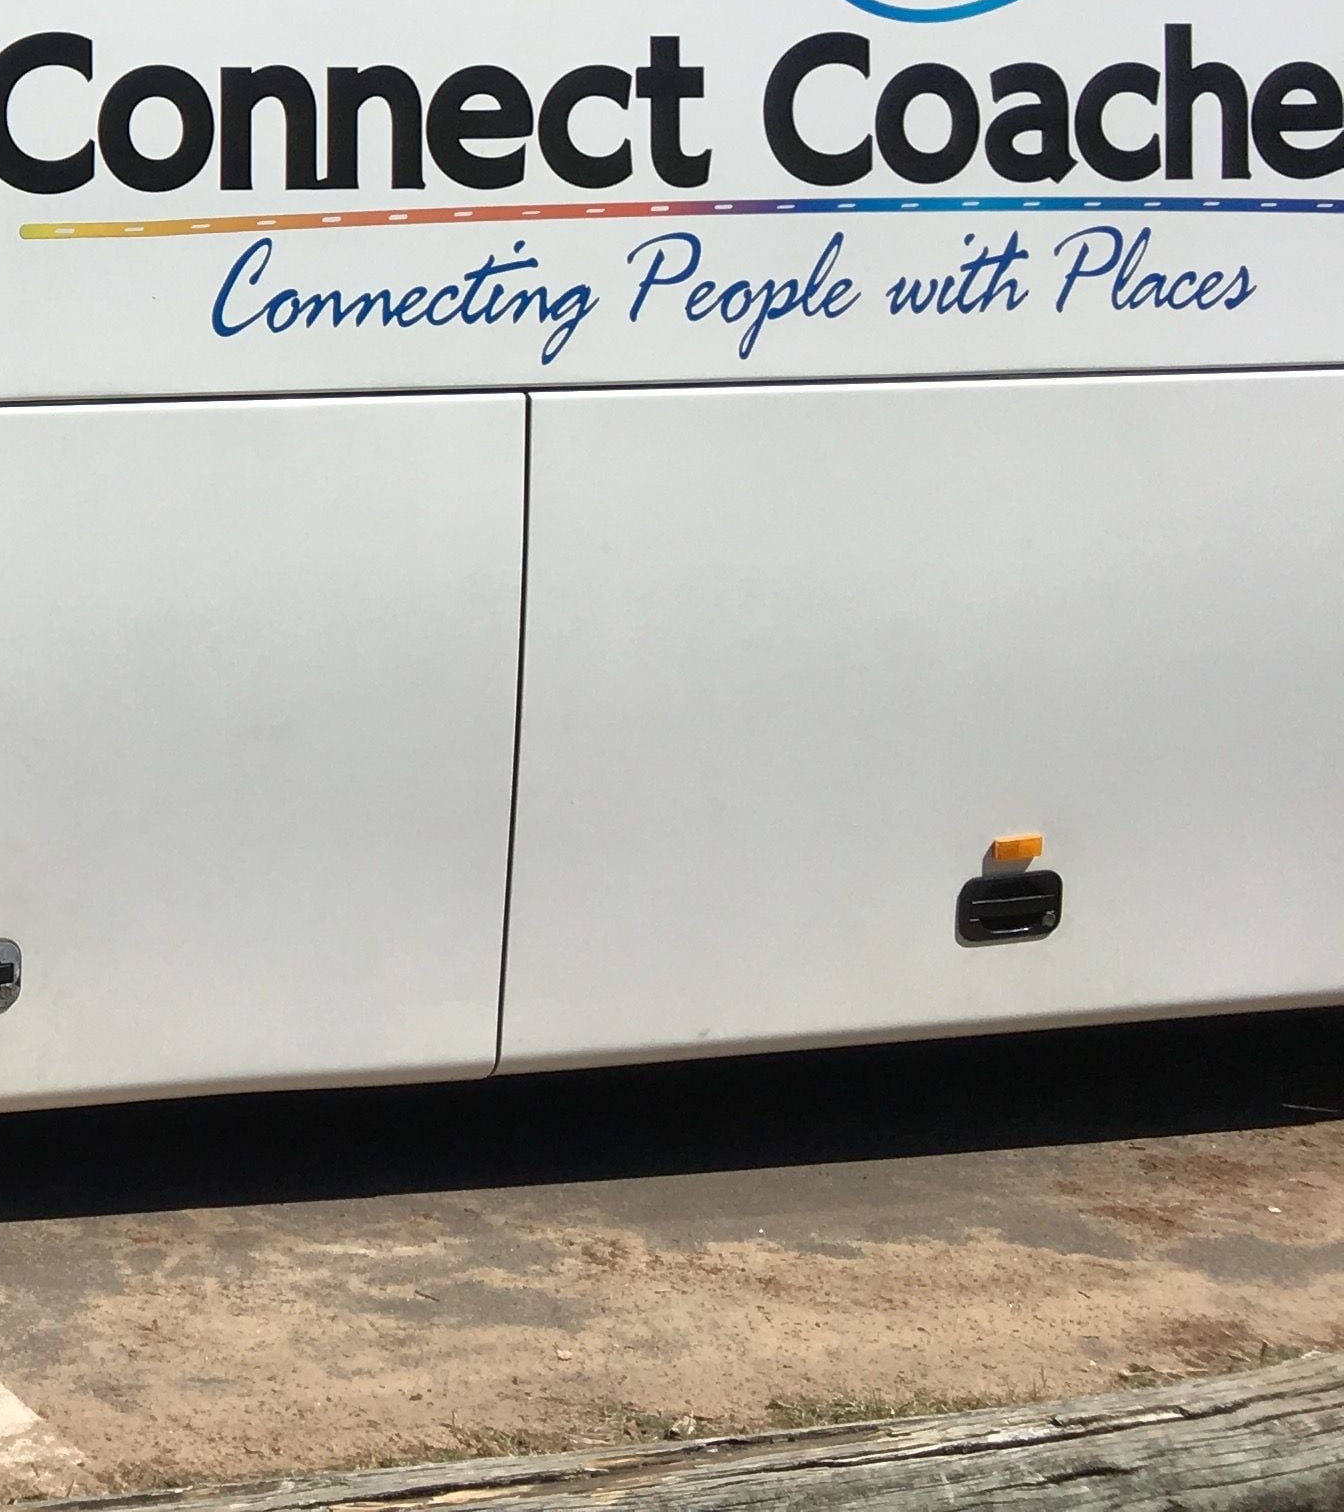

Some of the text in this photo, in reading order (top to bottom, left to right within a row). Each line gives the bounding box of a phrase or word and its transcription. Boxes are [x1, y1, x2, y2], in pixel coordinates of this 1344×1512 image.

[763, 23, 1344, 186] Coache
[213, 226, 1257, 365] Connecting People with Places
